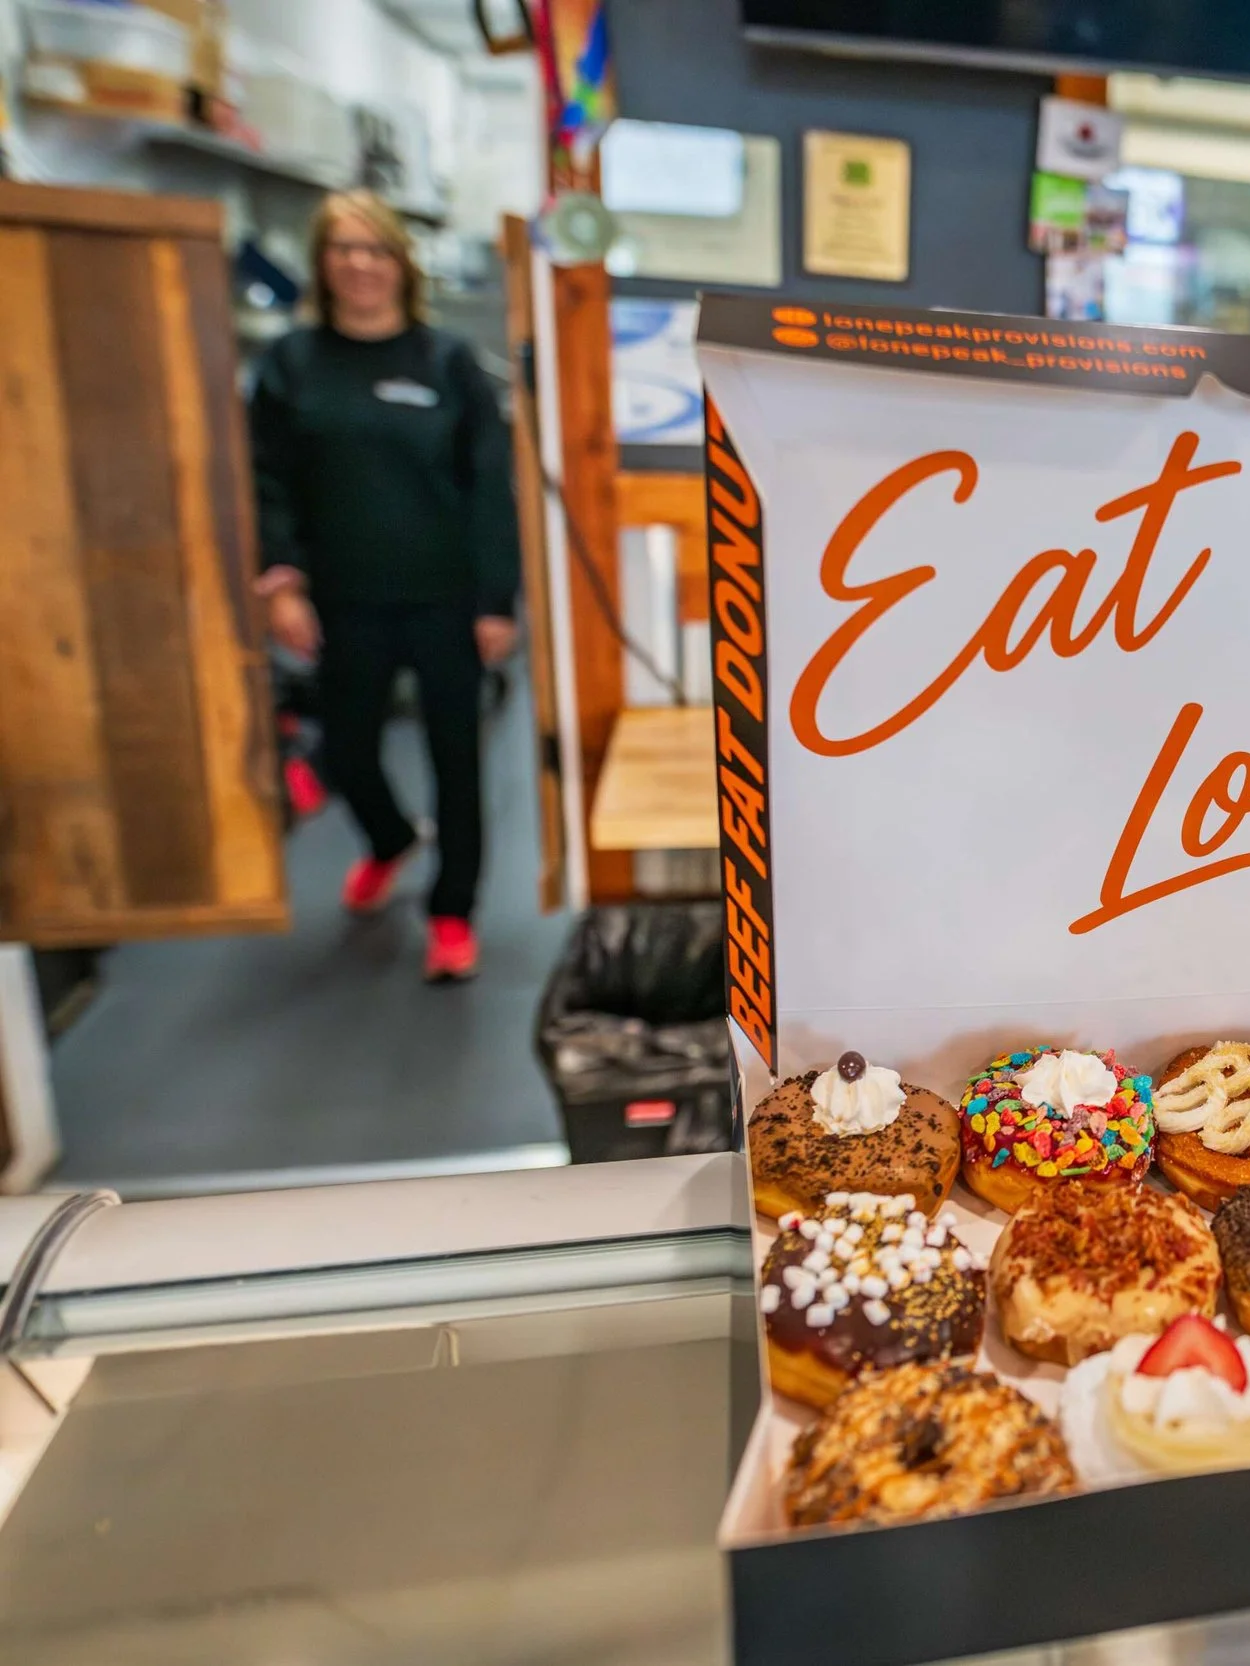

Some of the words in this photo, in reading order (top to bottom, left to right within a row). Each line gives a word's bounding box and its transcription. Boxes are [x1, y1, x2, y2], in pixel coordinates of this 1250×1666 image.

[822, 311, 1207, 361] lonepeakprovisions.com
[825, 332, 1188, 380] @lonepeak_provisions
[790, 431, 1242, 757] Eat
[717, 706, 767, 880] FAT
[724, 857, 773, 1068] BEEF
